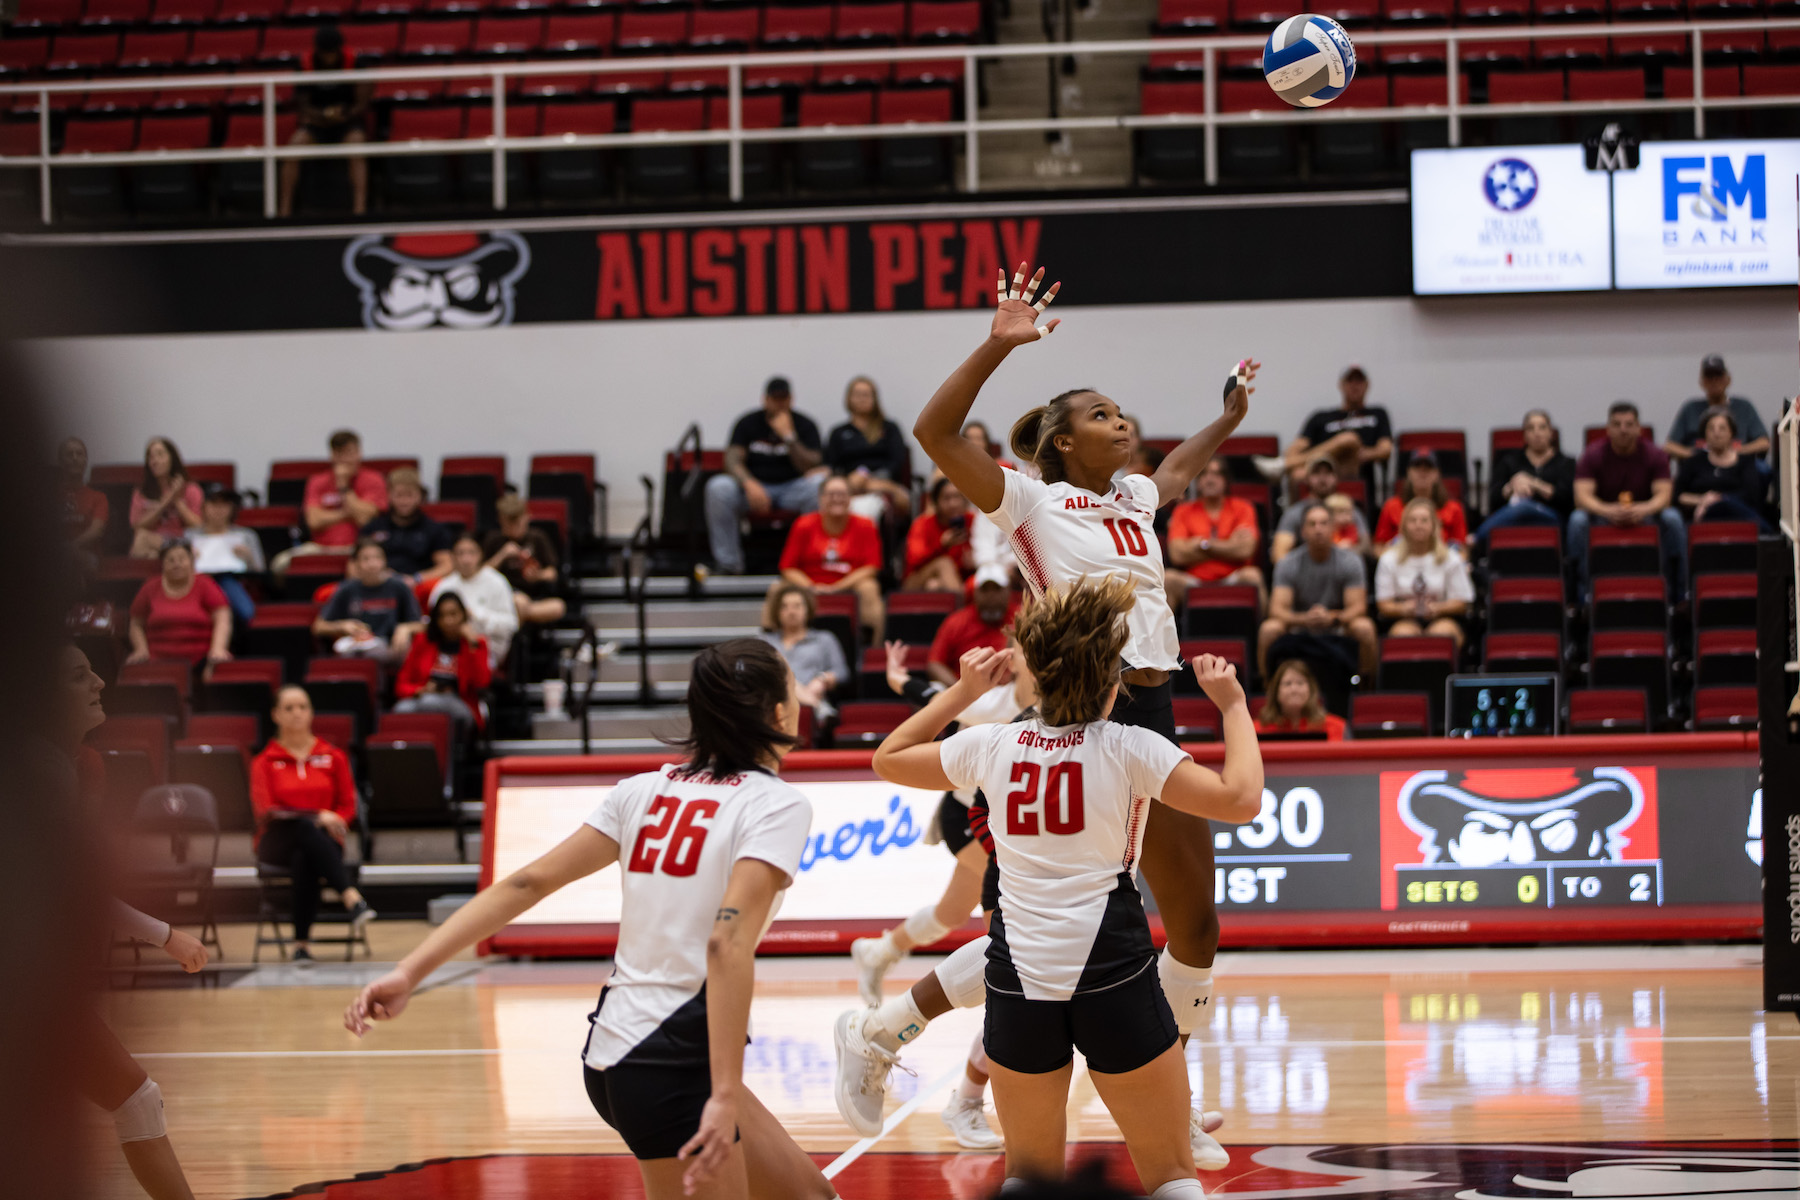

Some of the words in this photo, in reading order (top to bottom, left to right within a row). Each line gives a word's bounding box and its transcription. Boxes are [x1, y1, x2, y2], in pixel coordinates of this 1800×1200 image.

[1662, 155, 1767, 222] F&M
[595, 225, 850, 319] AUSTIN
[868, 218, 1042, 312] PEAY
[1662, 228, 1768, 244] BANK
[1103, 518, 1148, 557] 10
[1006, 761, 1085, 836] 20
[627, 795, 721, 878] 26
[1406, 880, 1480, 903] SETS
[1517, 875, 1540, 903] 0
[1562, 876, 1601, 898] TO
[1629, 873, 1652, 901] 2
